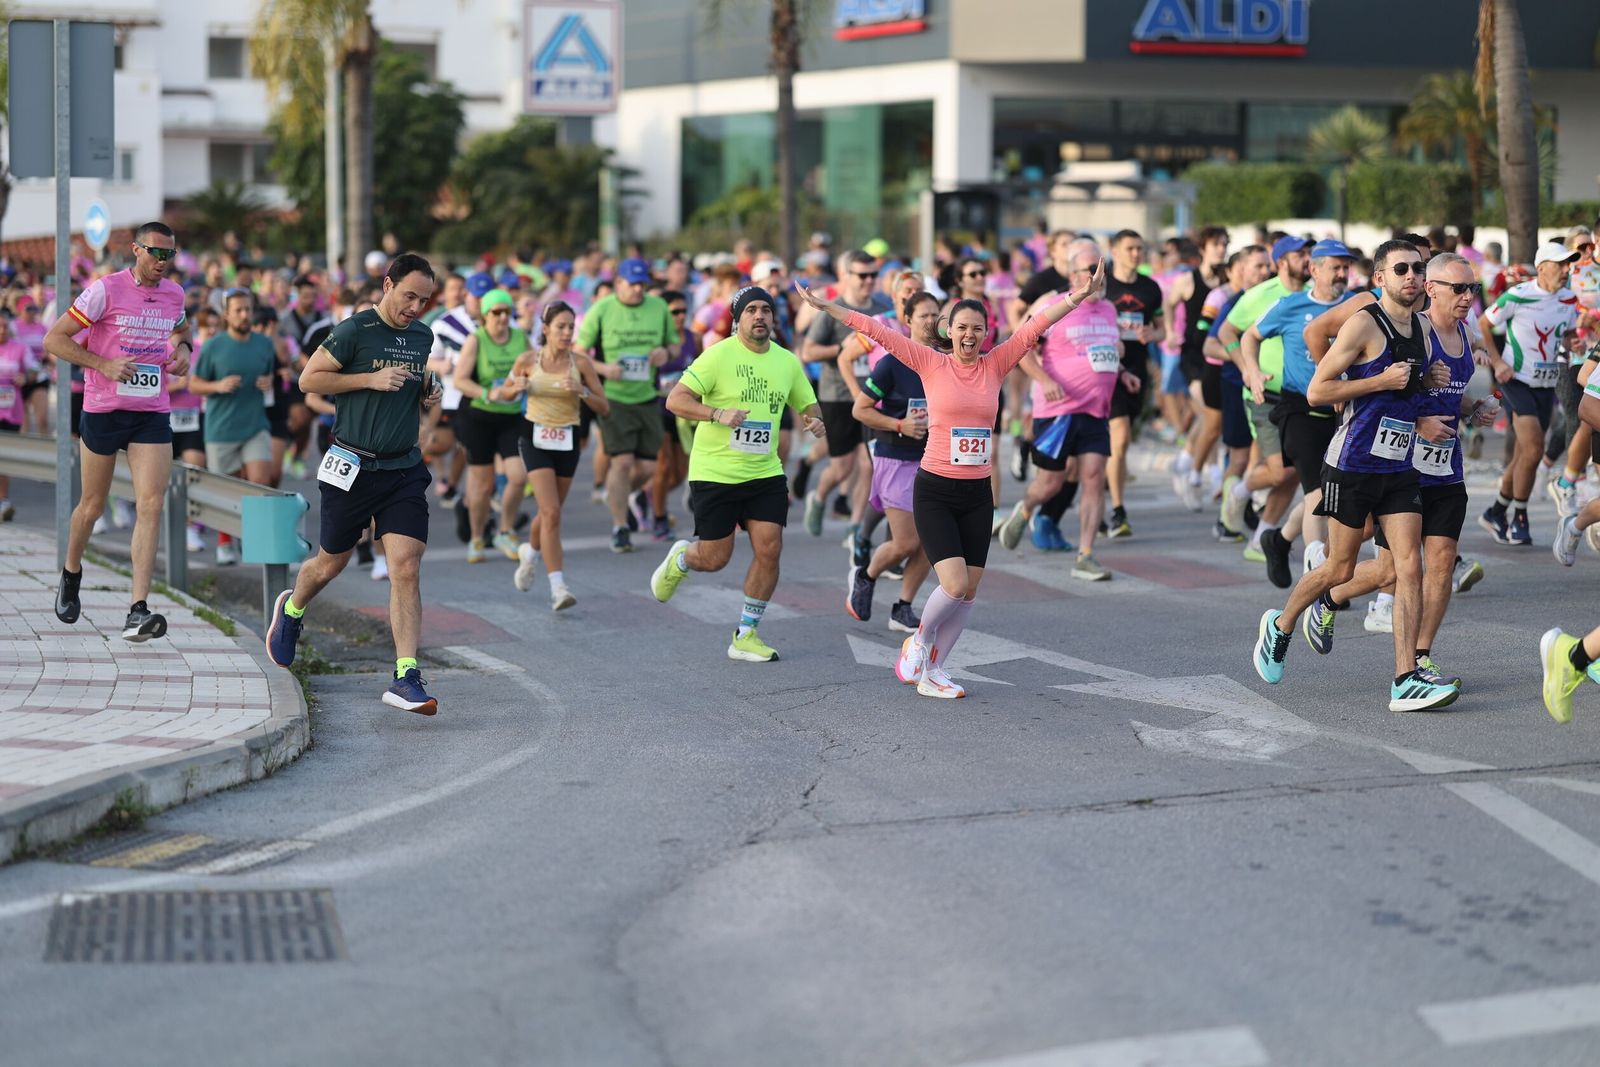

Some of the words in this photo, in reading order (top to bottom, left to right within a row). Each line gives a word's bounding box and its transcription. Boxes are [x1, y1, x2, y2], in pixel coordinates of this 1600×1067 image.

[1131, 0, 1309, 44] ALDI
[142, 308, 162, 317] XXXVI
[115, 315, 144, 328] MEDIA
[392, 353, 414, 361] ESTATES
[747, 377, 768, 390] ARE
[741, 388, 785, 404] RUNNERS
[541, 429, 566, 441] 205
[734, 428, 770, 444] 1123
[1380, 429, 1410, 449] 1709
[958, 438, 986, 453] 821
[1422, 446, 1450, 464] 713
[324, 455, 352, 477] 813
